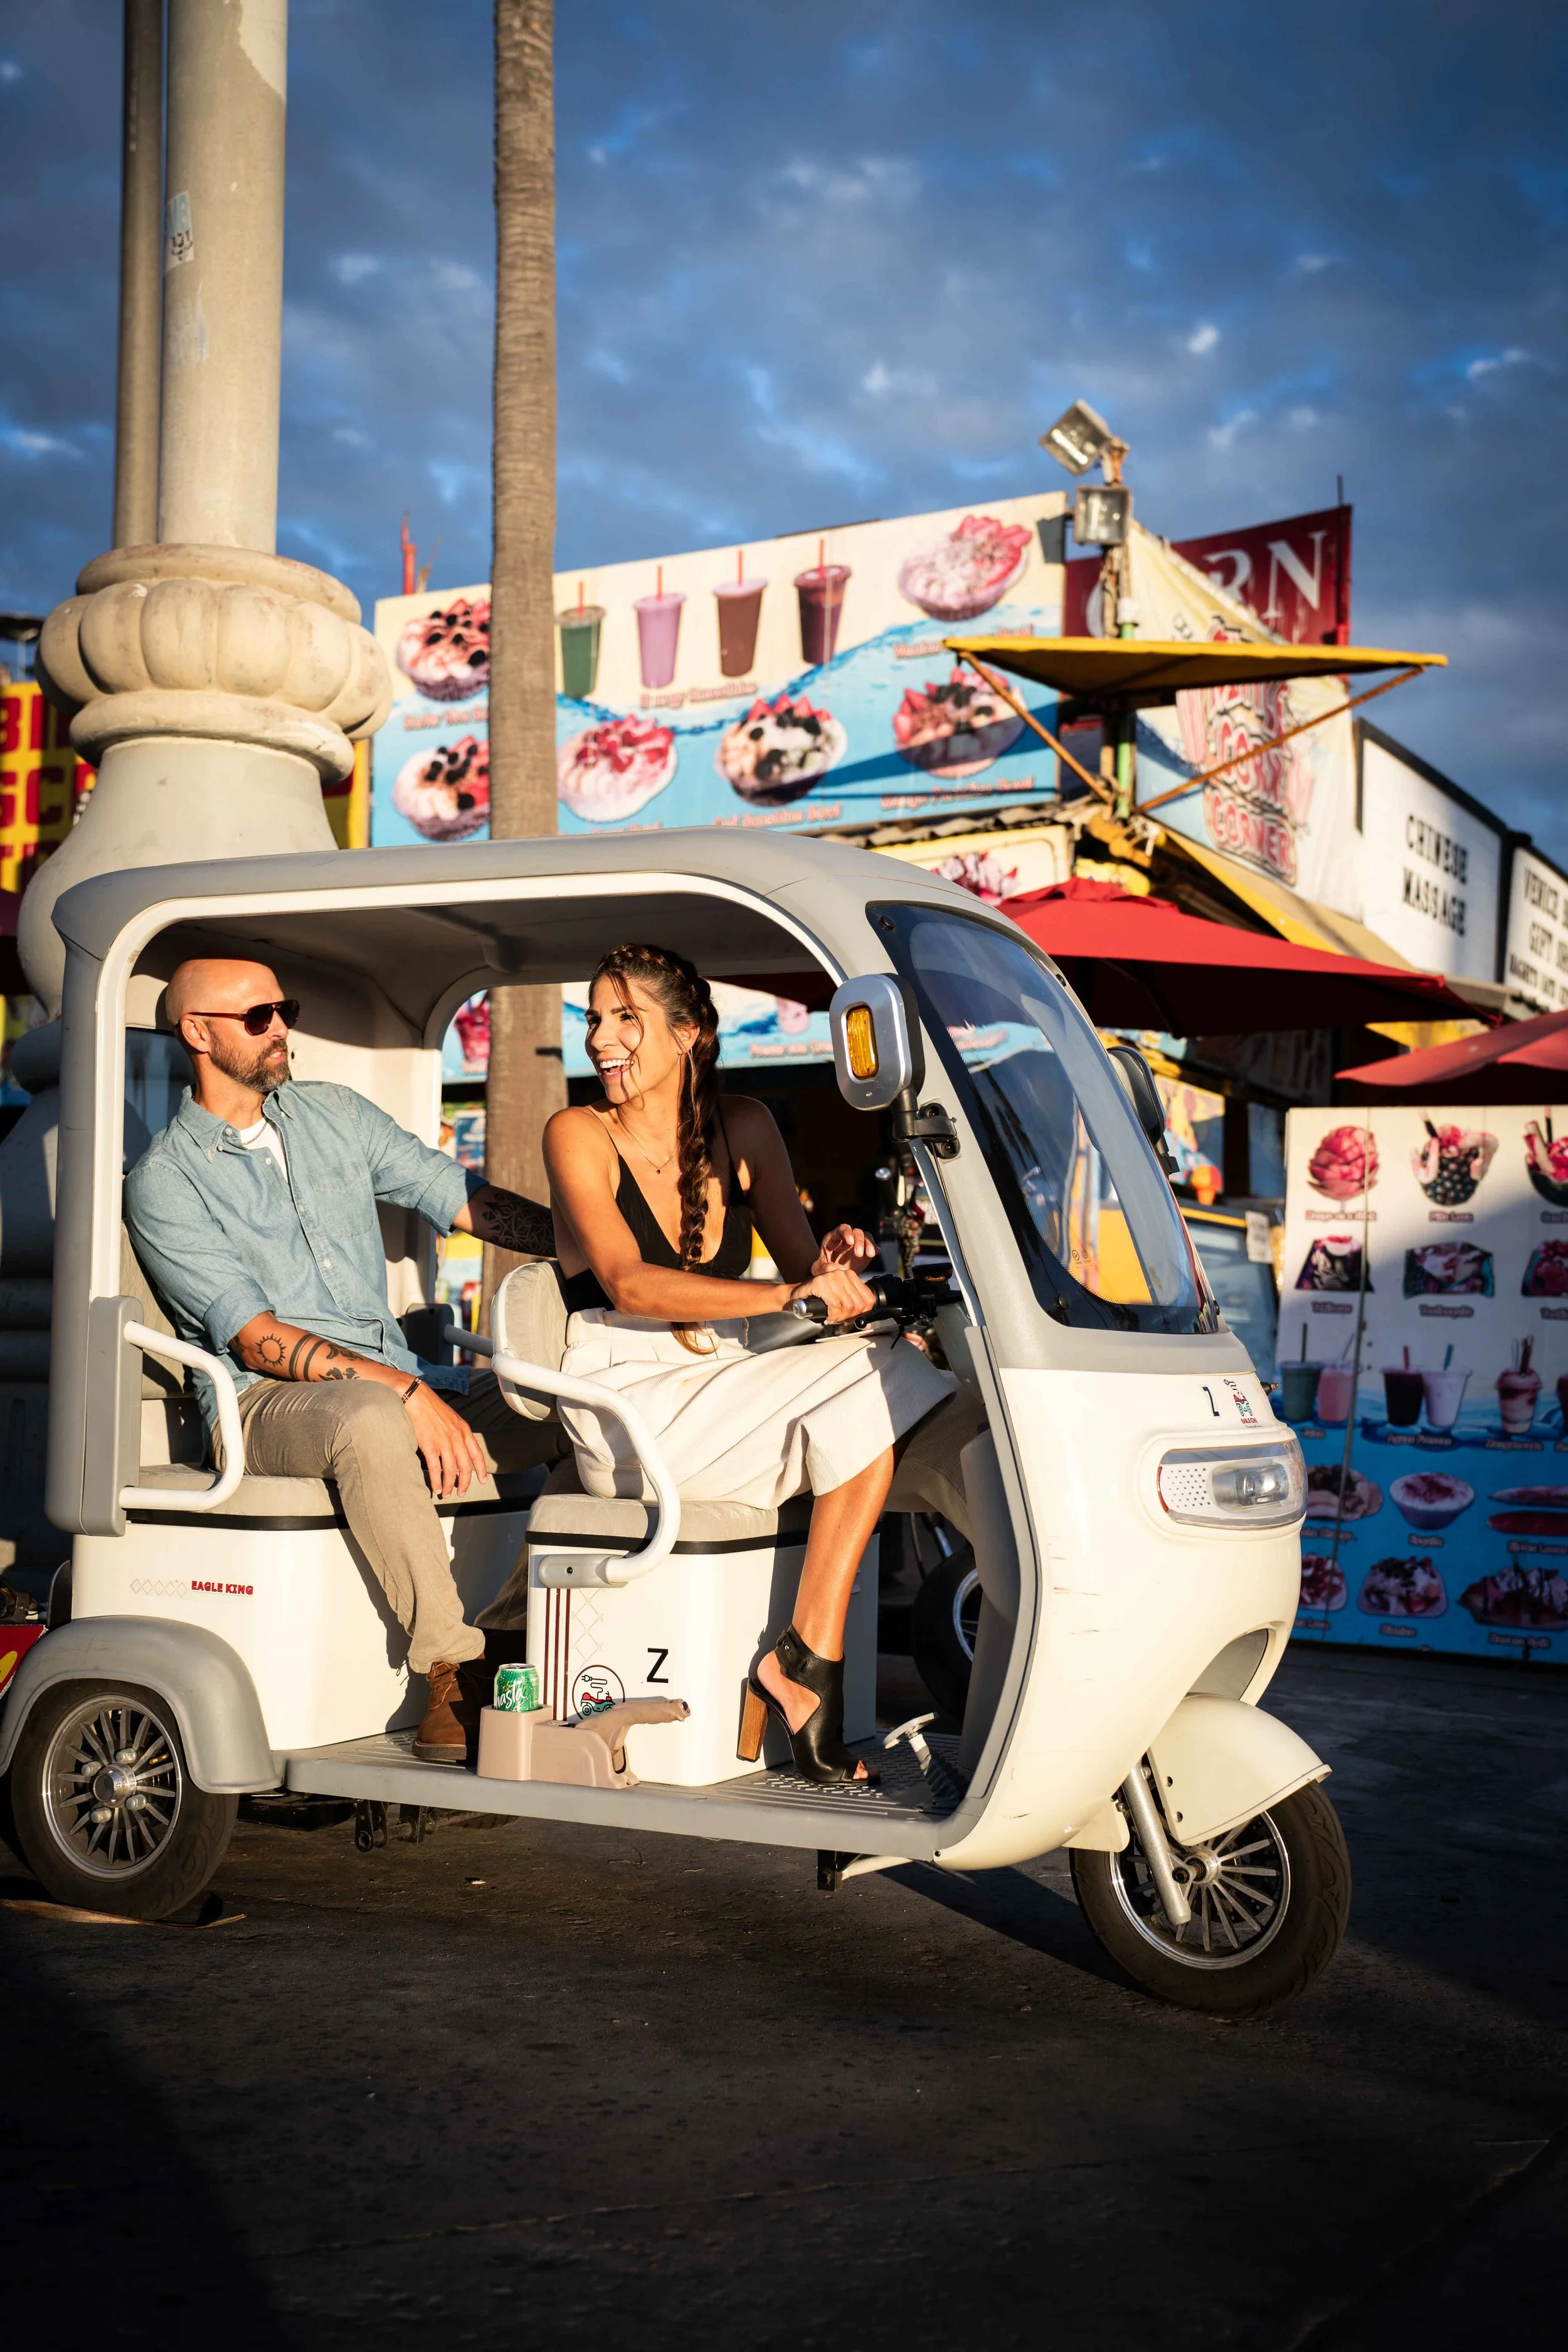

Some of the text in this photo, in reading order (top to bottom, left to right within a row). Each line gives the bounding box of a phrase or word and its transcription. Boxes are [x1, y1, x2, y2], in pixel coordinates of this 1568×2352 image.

[1406, 814, 1468, 885] CHINESE
[1402, 866, 1466, 936] MASSAGE
[1524, 866, 1559, 921] VENICE
[191, 1581, 253, 1595] EAGLE KING
[647, 1648, 669, 1683] Z
[497, 1680, 528, 1710] asta
